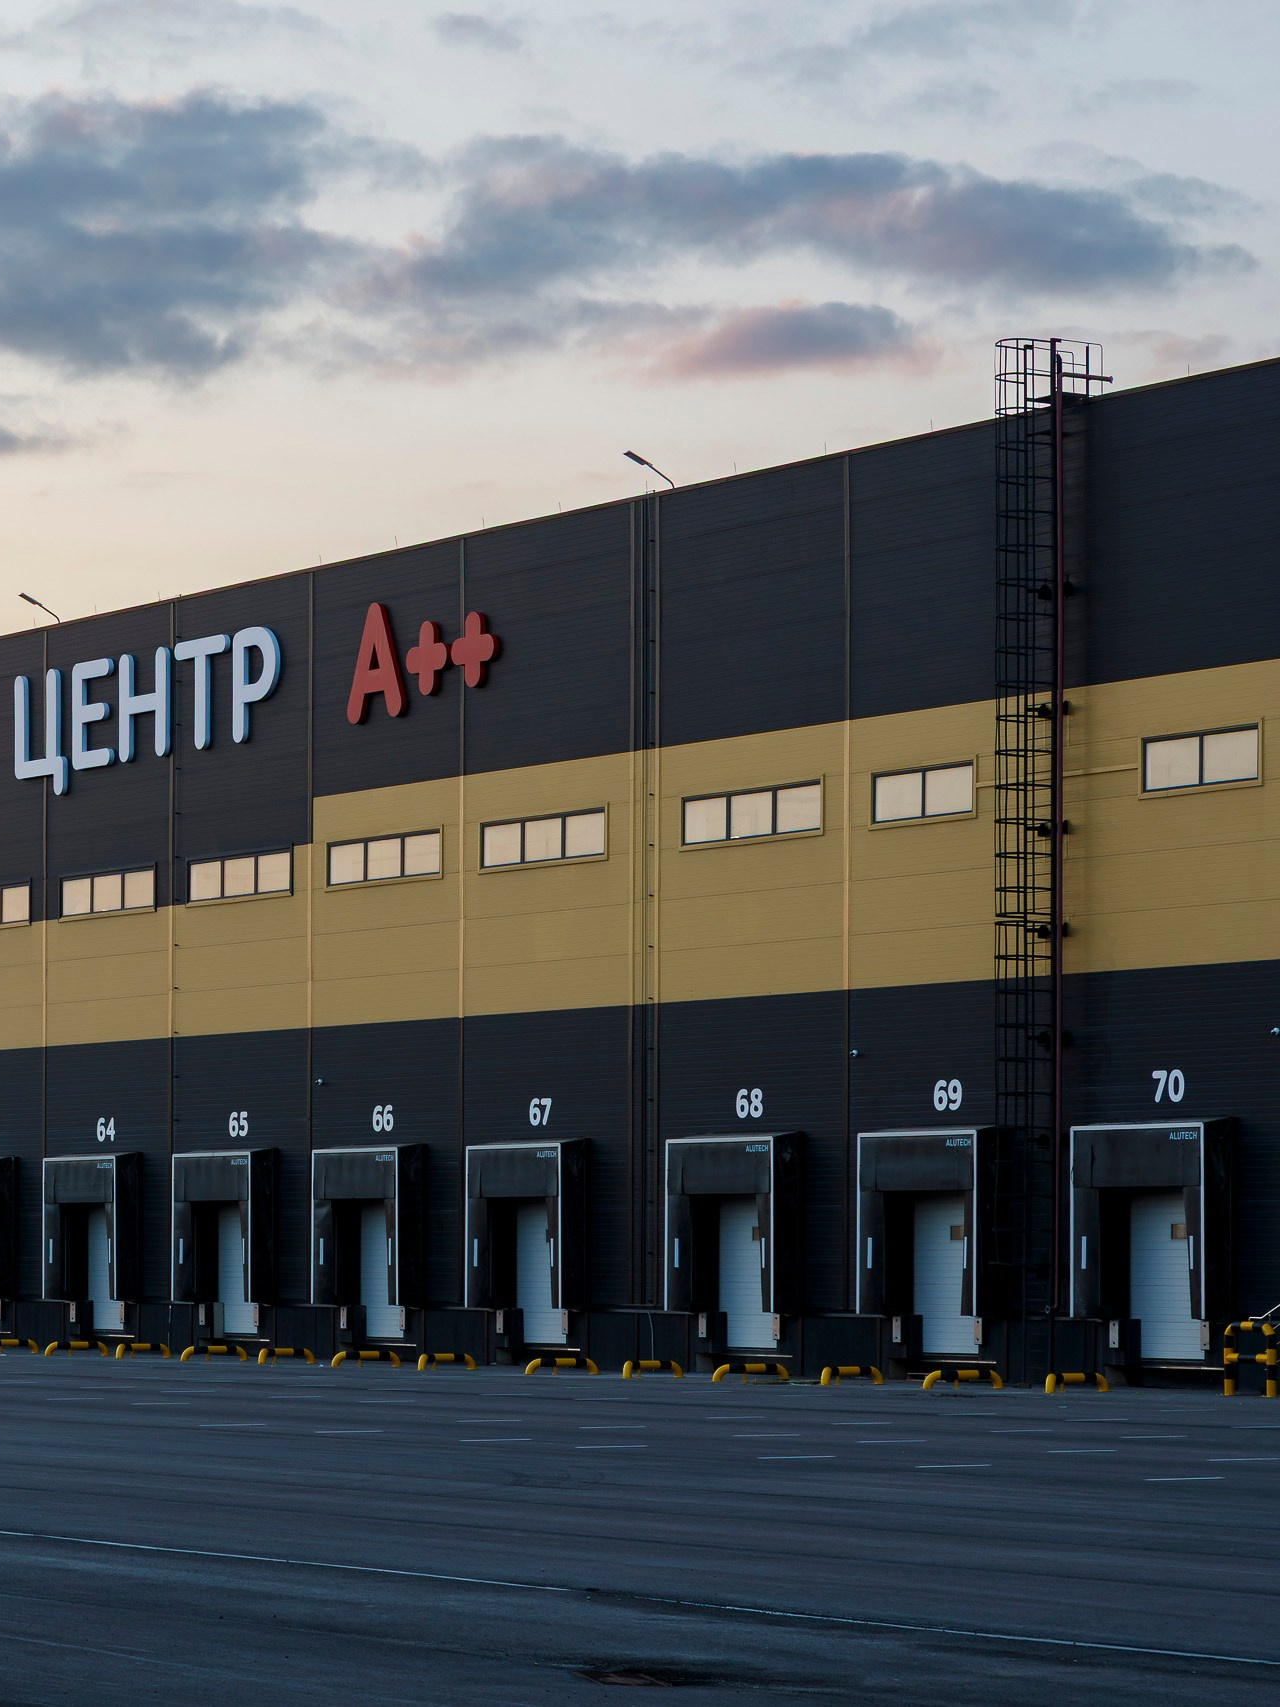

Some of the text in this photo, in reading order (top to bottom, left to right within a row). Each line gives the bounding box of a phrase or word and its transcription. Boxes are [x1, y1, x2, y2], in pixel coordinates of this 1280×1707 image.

[12, 625, 282, 797] ЦЕНТР
[933, 1079, 963, 1111] 69
[1152, 1069, 1185, 1103] 70
[529, 1098, 552, 1126] 67
[736, 1088, 763, 1118] 68
[96, 1117, 115, 1141] 64
[229, 1111, 249, 1137] 65
[372, 1105, 394, 1132] 66
[945, 1138, 972, 1147] ALUTECH
[1168, 1131, 1198, 1140] ALUTECH
[374, 1154, 394, 1162] ALUTECH
[536, 1150, 557, 1158] ALUTECH
[745, 1144, 769, 1153] ALUTECH
[230, 1158, 248, 1166] ALUTECH
